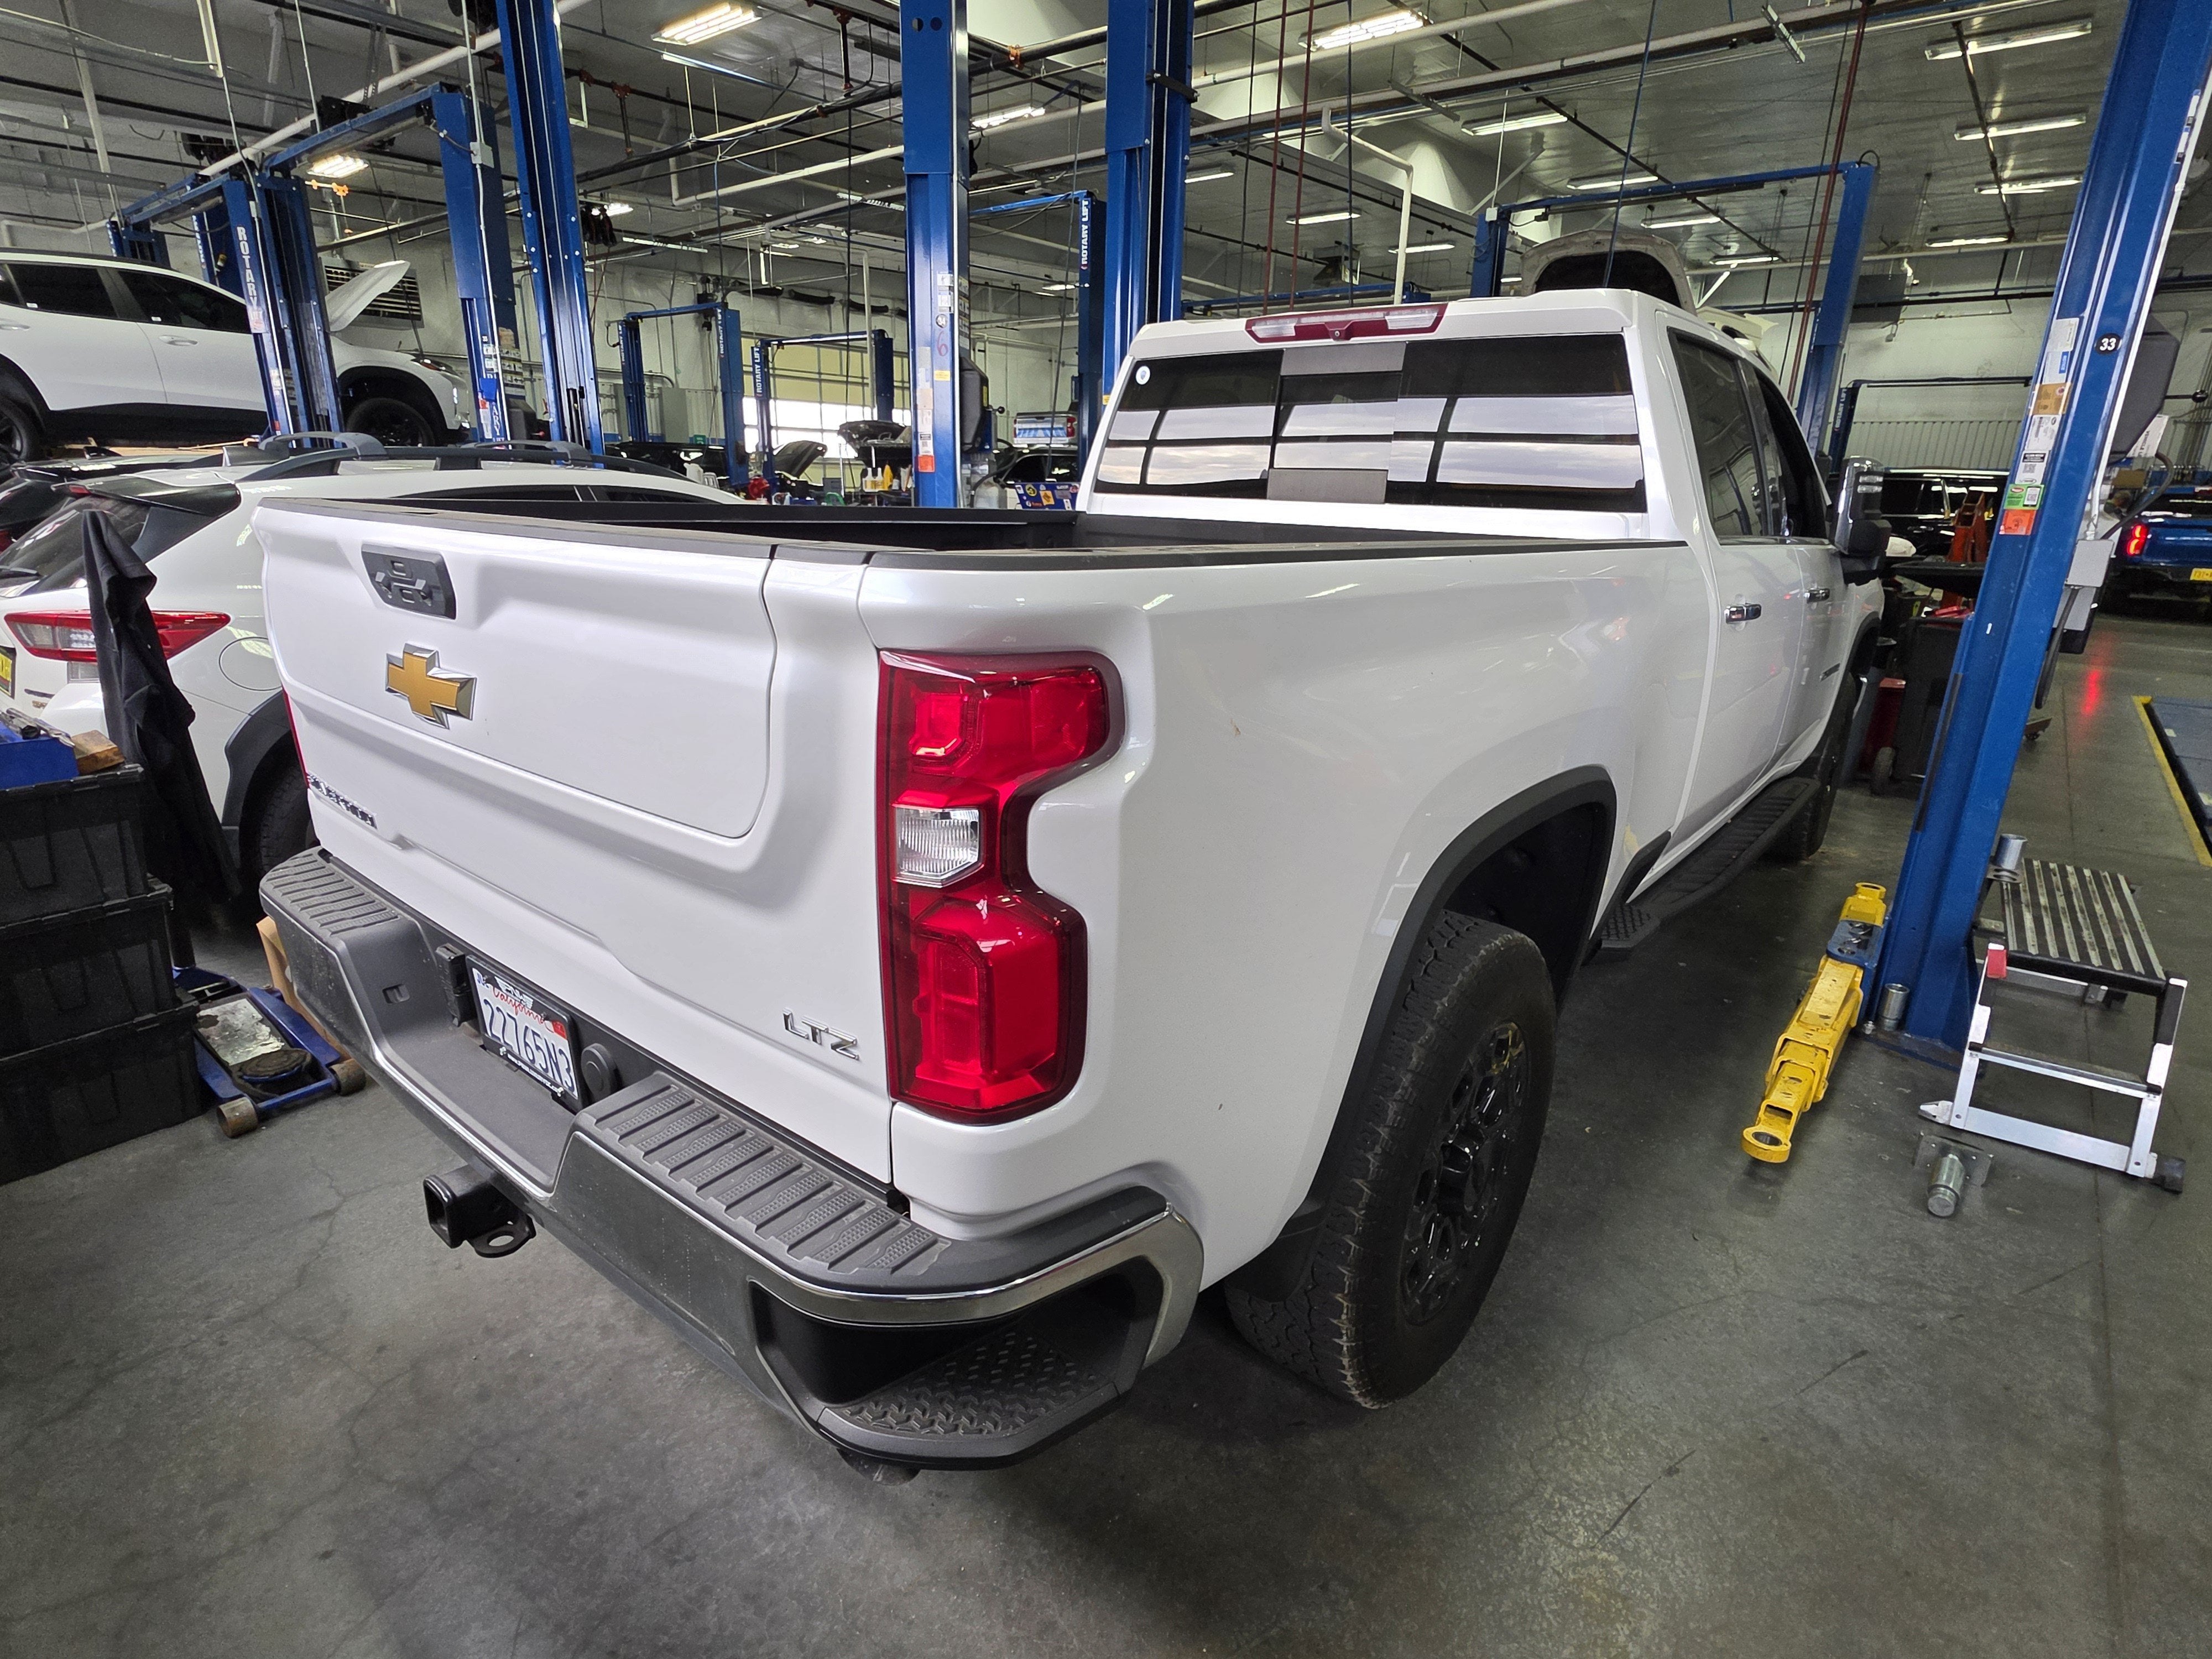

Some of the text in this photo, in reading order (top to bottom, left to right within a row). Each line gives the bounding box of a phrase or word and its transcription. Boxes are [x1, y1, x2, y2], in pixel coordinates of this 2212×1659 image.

[237, 227, 257, 311] ROTARY
[937, 330, 948, 357] 6
[2100, 337, 2117, 351] 33
[483, 999, 575, 1093] 22765N3
[783, 1008, 860, 1061] LTZ
